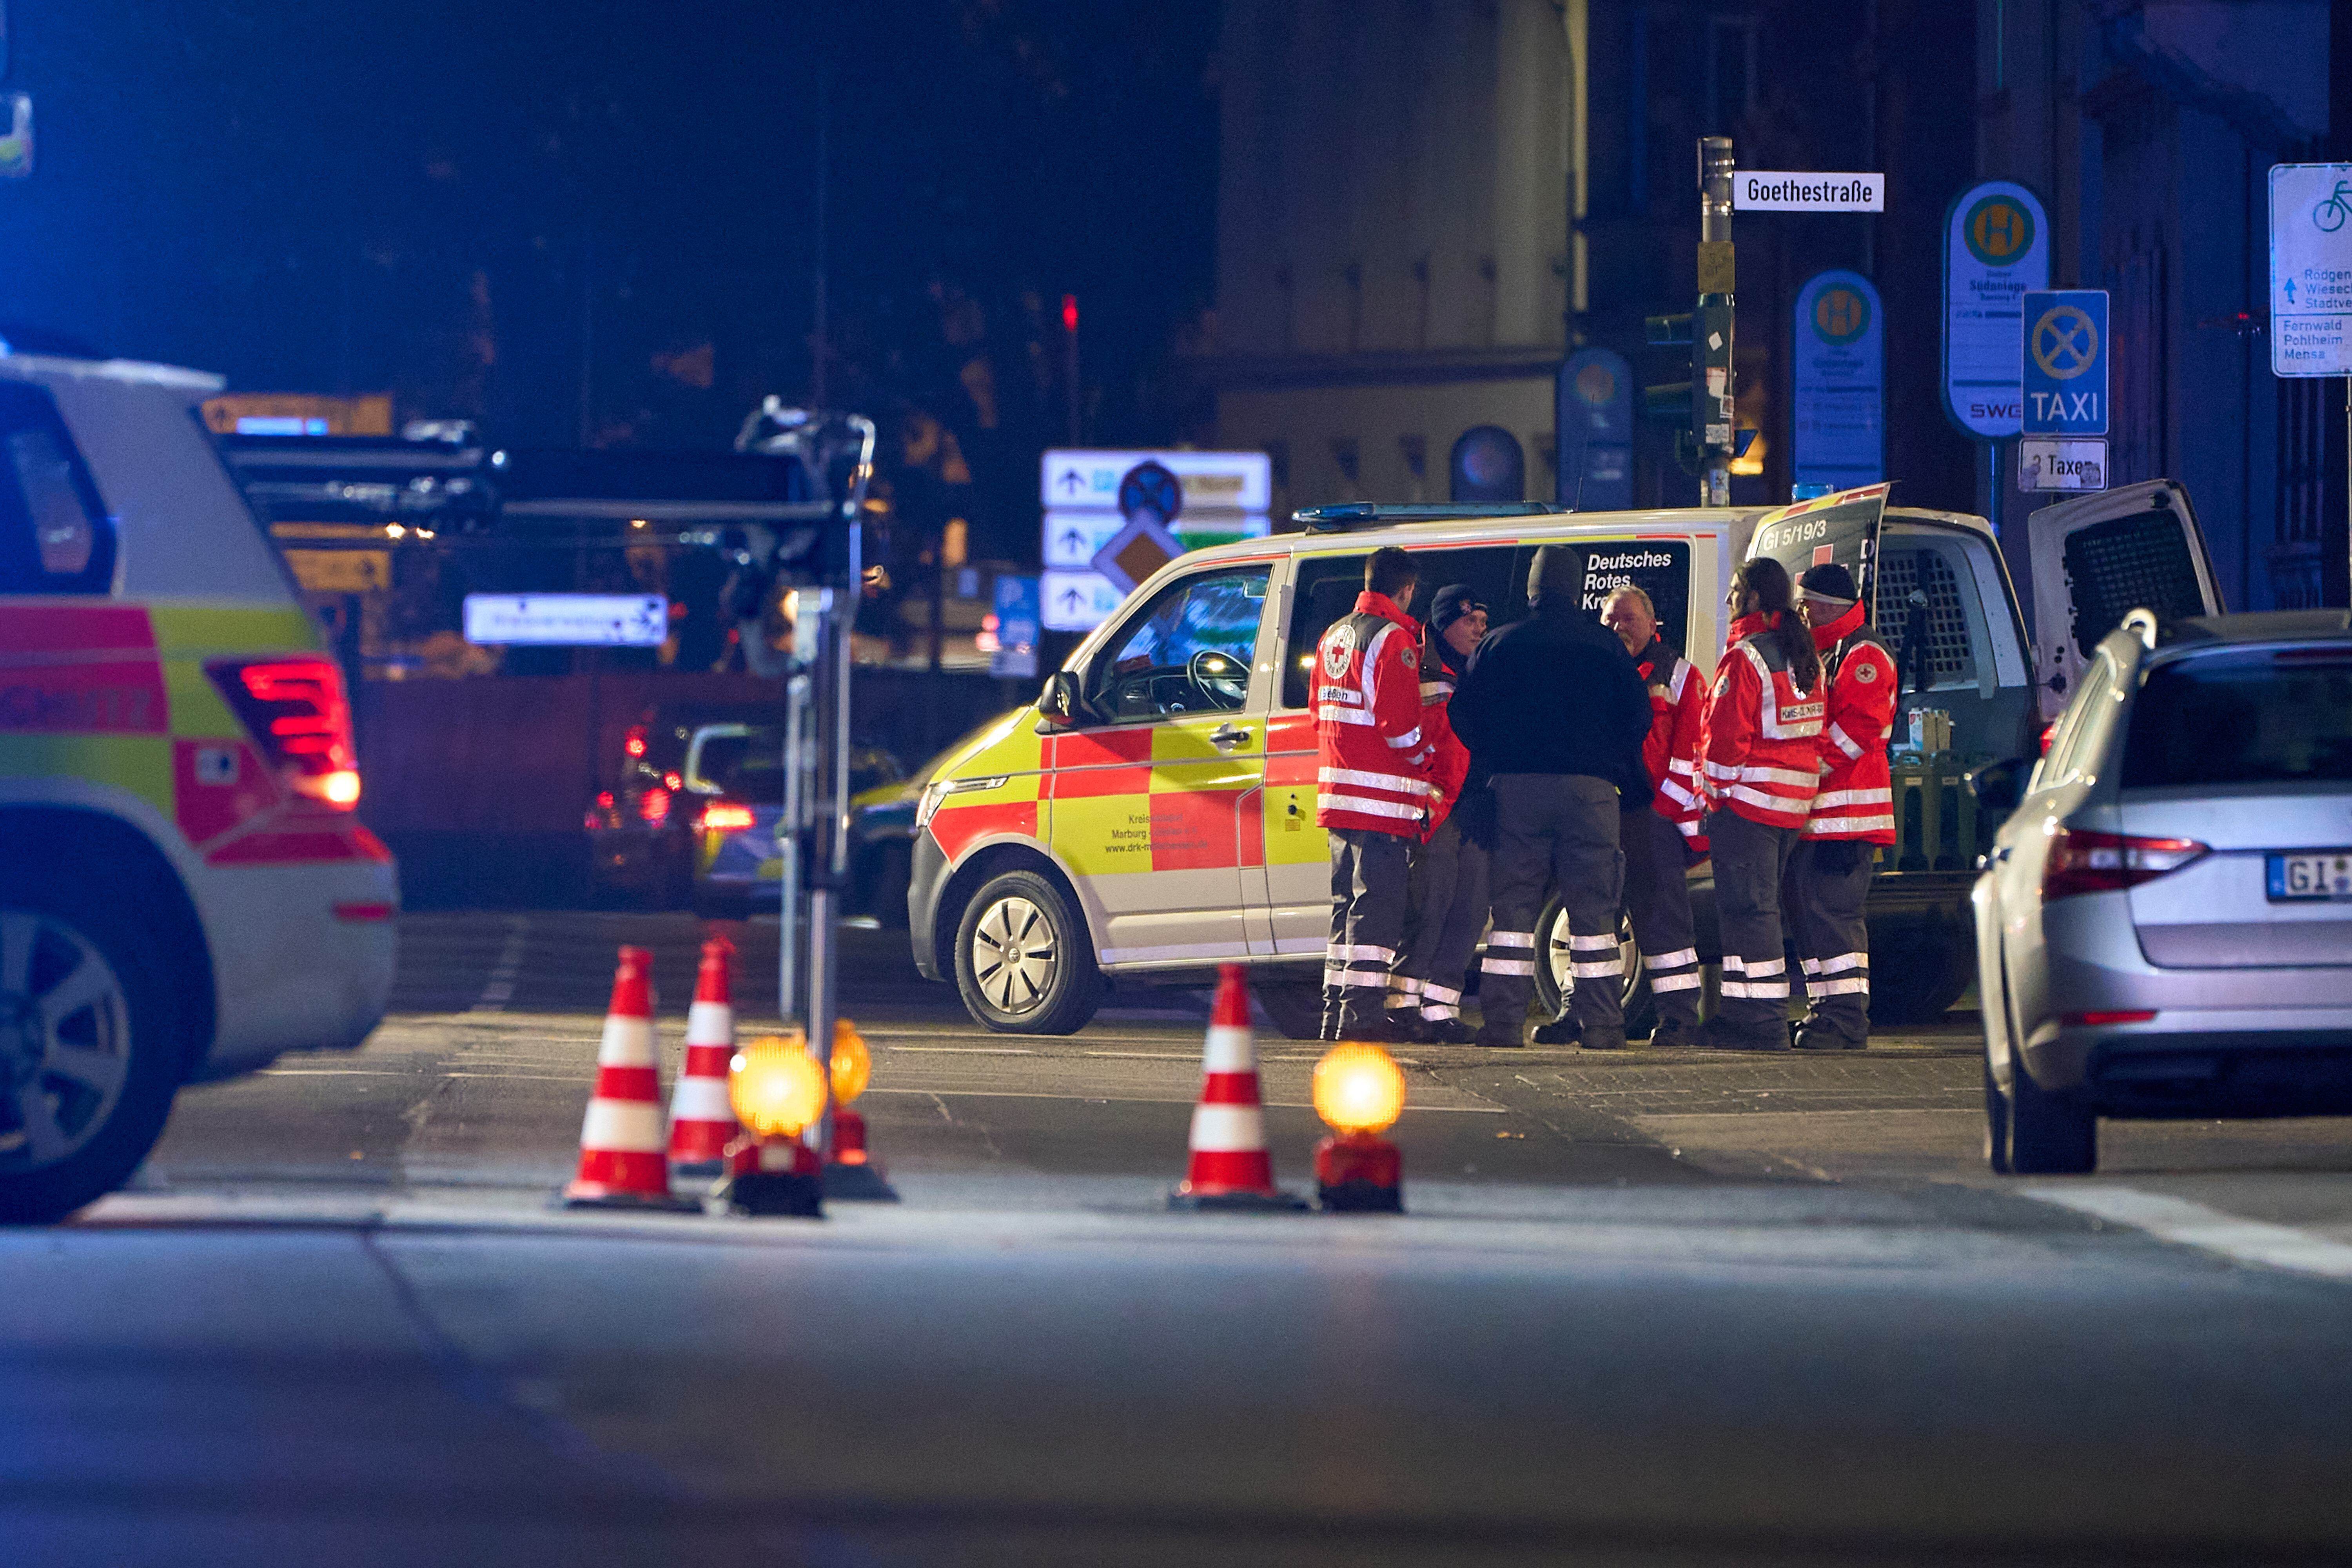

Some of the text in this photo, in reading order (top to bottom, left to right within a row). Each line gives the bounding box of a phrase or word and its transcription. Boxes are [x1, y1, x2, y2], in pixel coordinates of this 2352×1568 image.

[1748, 178, 1873, 202] Goethestraße
[2306, 283, 2352, 294] Wiesec
[2283, 320, 2342, 331] Fernwald
[2284, 334, 2342, 345] Pohlheim
[2285, 348, 2326, 359] Mensa
[2031, 392, 2098, 421] TAXI
[1764, 519, 1827, 551] GI 5/19/3
[1588, 550, 1671, 571] Deutsches
[1584, 573, 1631, 590] Rotes
[1582, 593, 1608, 610] Kre
[1112, 829, 1147, 839] Marburg
[2289, 862, 2328, 891] GI
